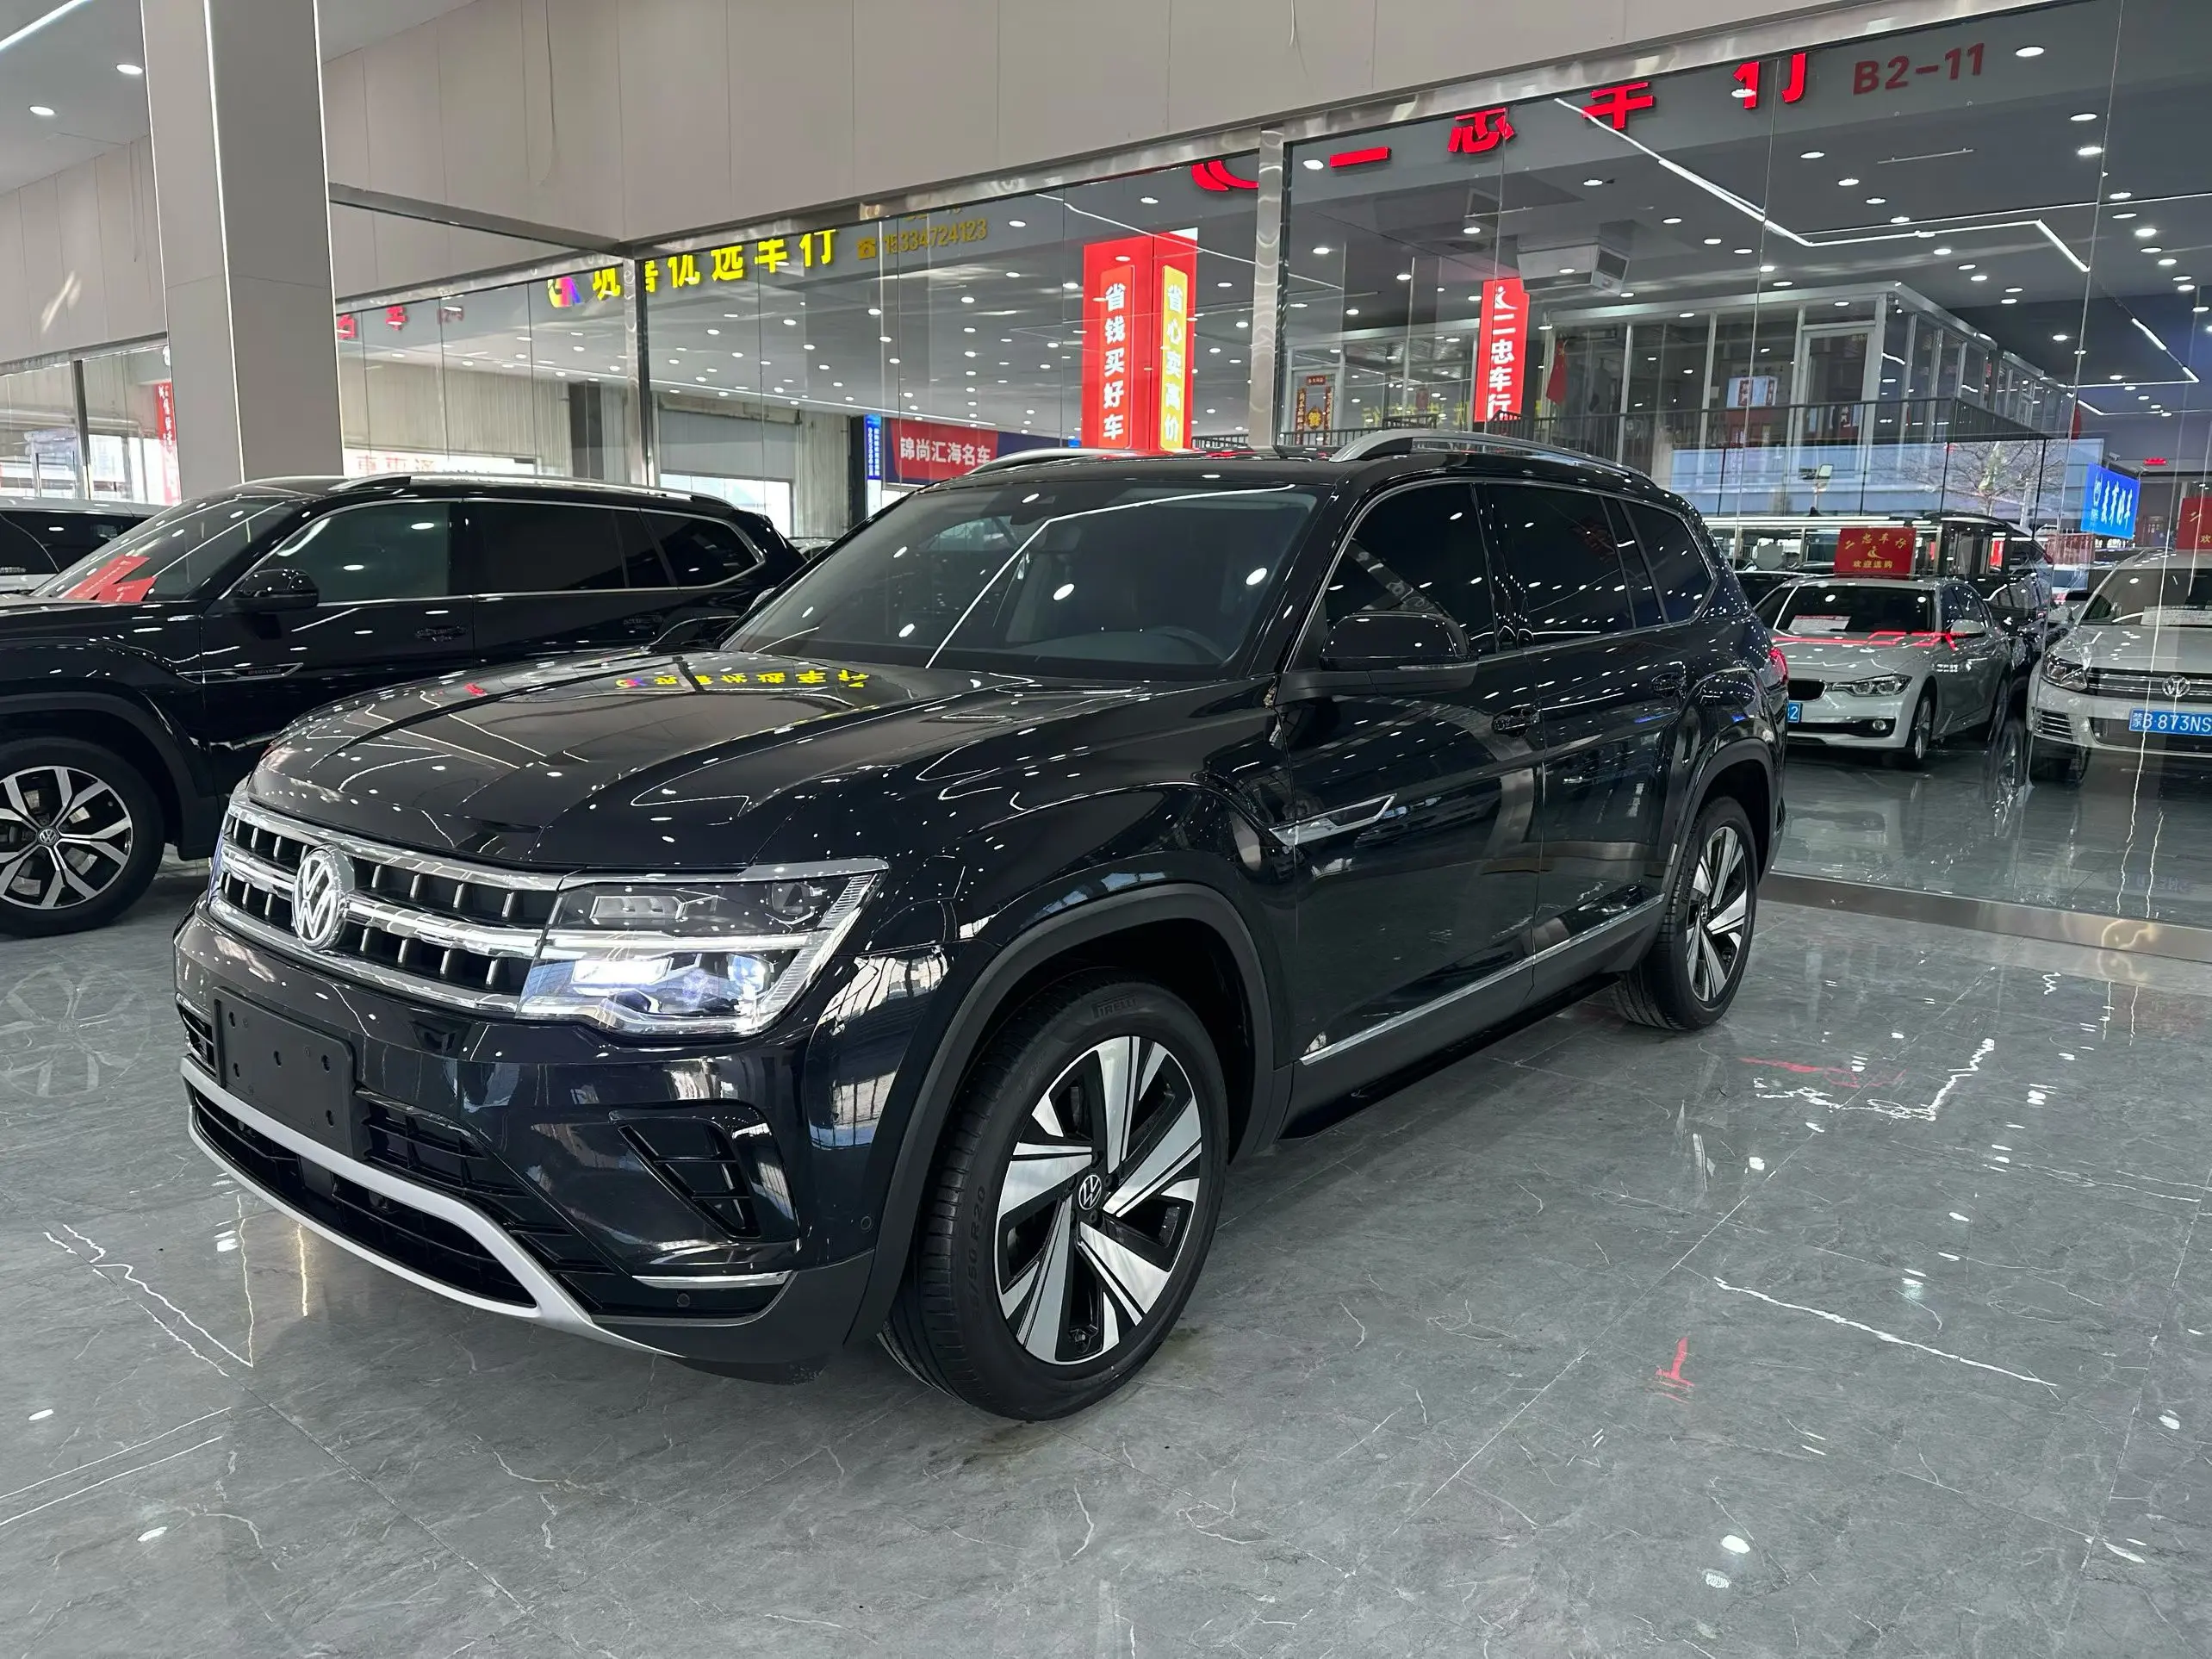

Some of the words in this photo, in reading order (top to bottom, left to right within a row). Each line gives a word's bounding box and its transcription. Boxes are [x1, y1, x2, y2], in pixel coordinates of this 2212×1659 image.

[1853, 42, 1985, 95] B2-11
[1103, 283, 1126, 441] 省钱买好车
[1164, 284, 1184, 442] 省心卖高价
[1487, 314, 1516, 420] 二忠车行
[900, 437, 991, 466] 锦尚汇海名车
[1853, 560, 1893, 569] 欢迎选购
